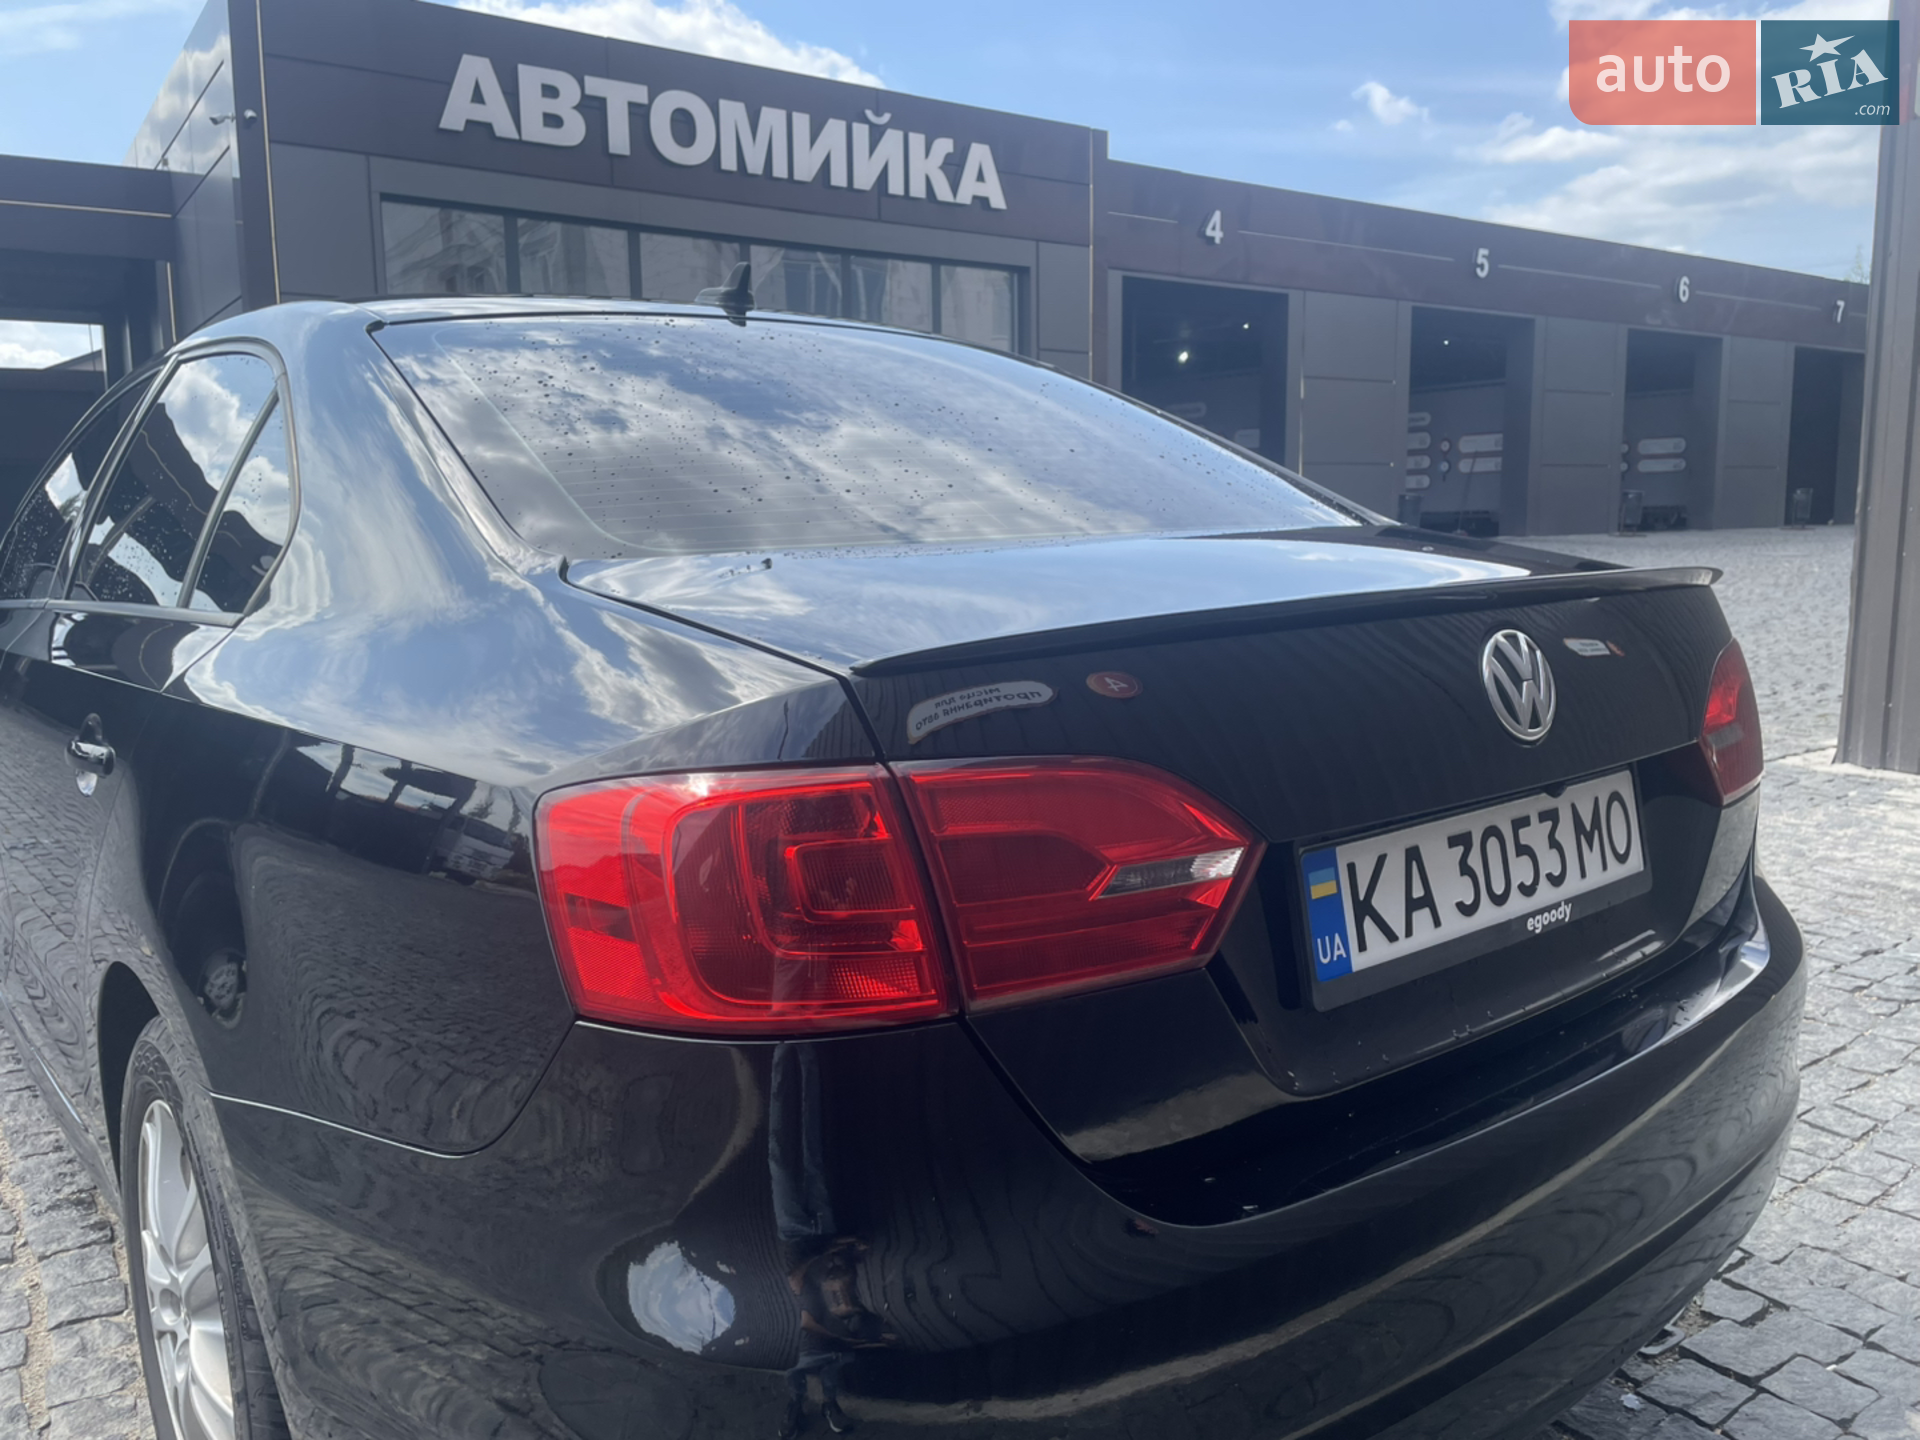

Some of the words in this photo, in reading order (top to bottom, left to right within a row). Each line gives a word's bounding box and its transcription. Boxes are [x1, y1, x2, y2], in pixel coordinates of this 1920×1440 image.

[438, 53, 1008, 210] АВТОМИЙКА
[1205, 210, 1224, 245] 4
[1476, 247, 1490, 279] 5
[1679, 275, 1690, 303] 6
[1836, 299, 1845, 323] 7
[1346, 844, 1442, 953] KA
[1447, 806, 1567, 918] 3053
[1571, 790, 1633, 880] MO
[1526, 900, 1573, 934] egoody
[1316, 932, 1347, 965] UA
